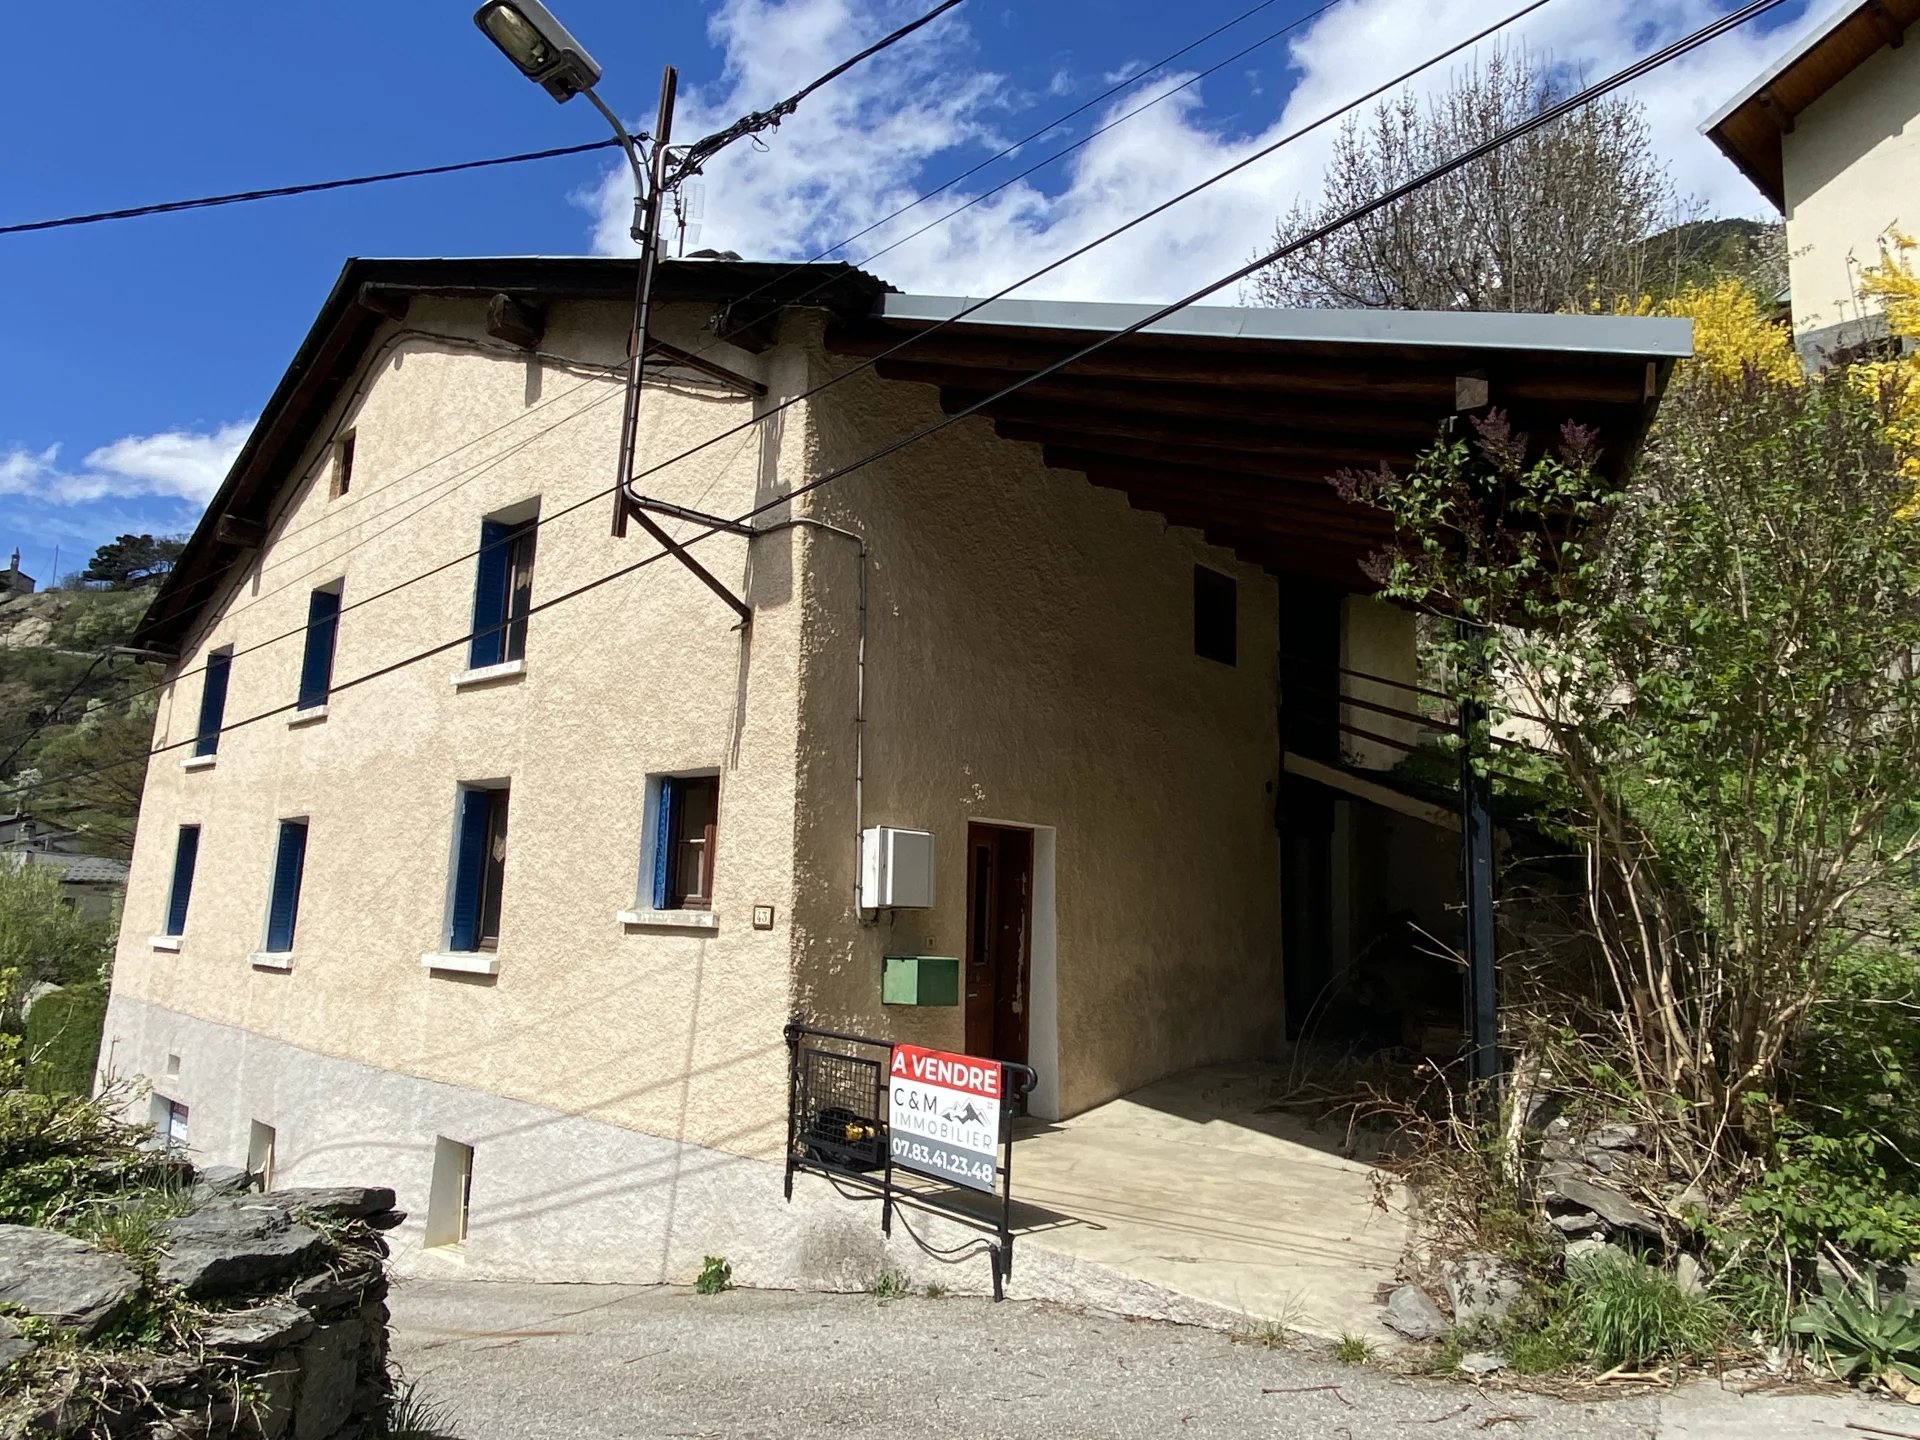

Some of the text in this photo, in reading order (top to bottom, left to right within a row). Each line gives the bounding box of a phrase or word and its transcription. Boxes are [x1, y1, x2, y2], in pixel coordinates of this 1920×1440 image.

[892, 1052, 997, 1094] A VENDRE
[894, 1112, 992, 1150] IMMOBILIER
[892, 1137, 993, 1183] 07.83.41.23.48
